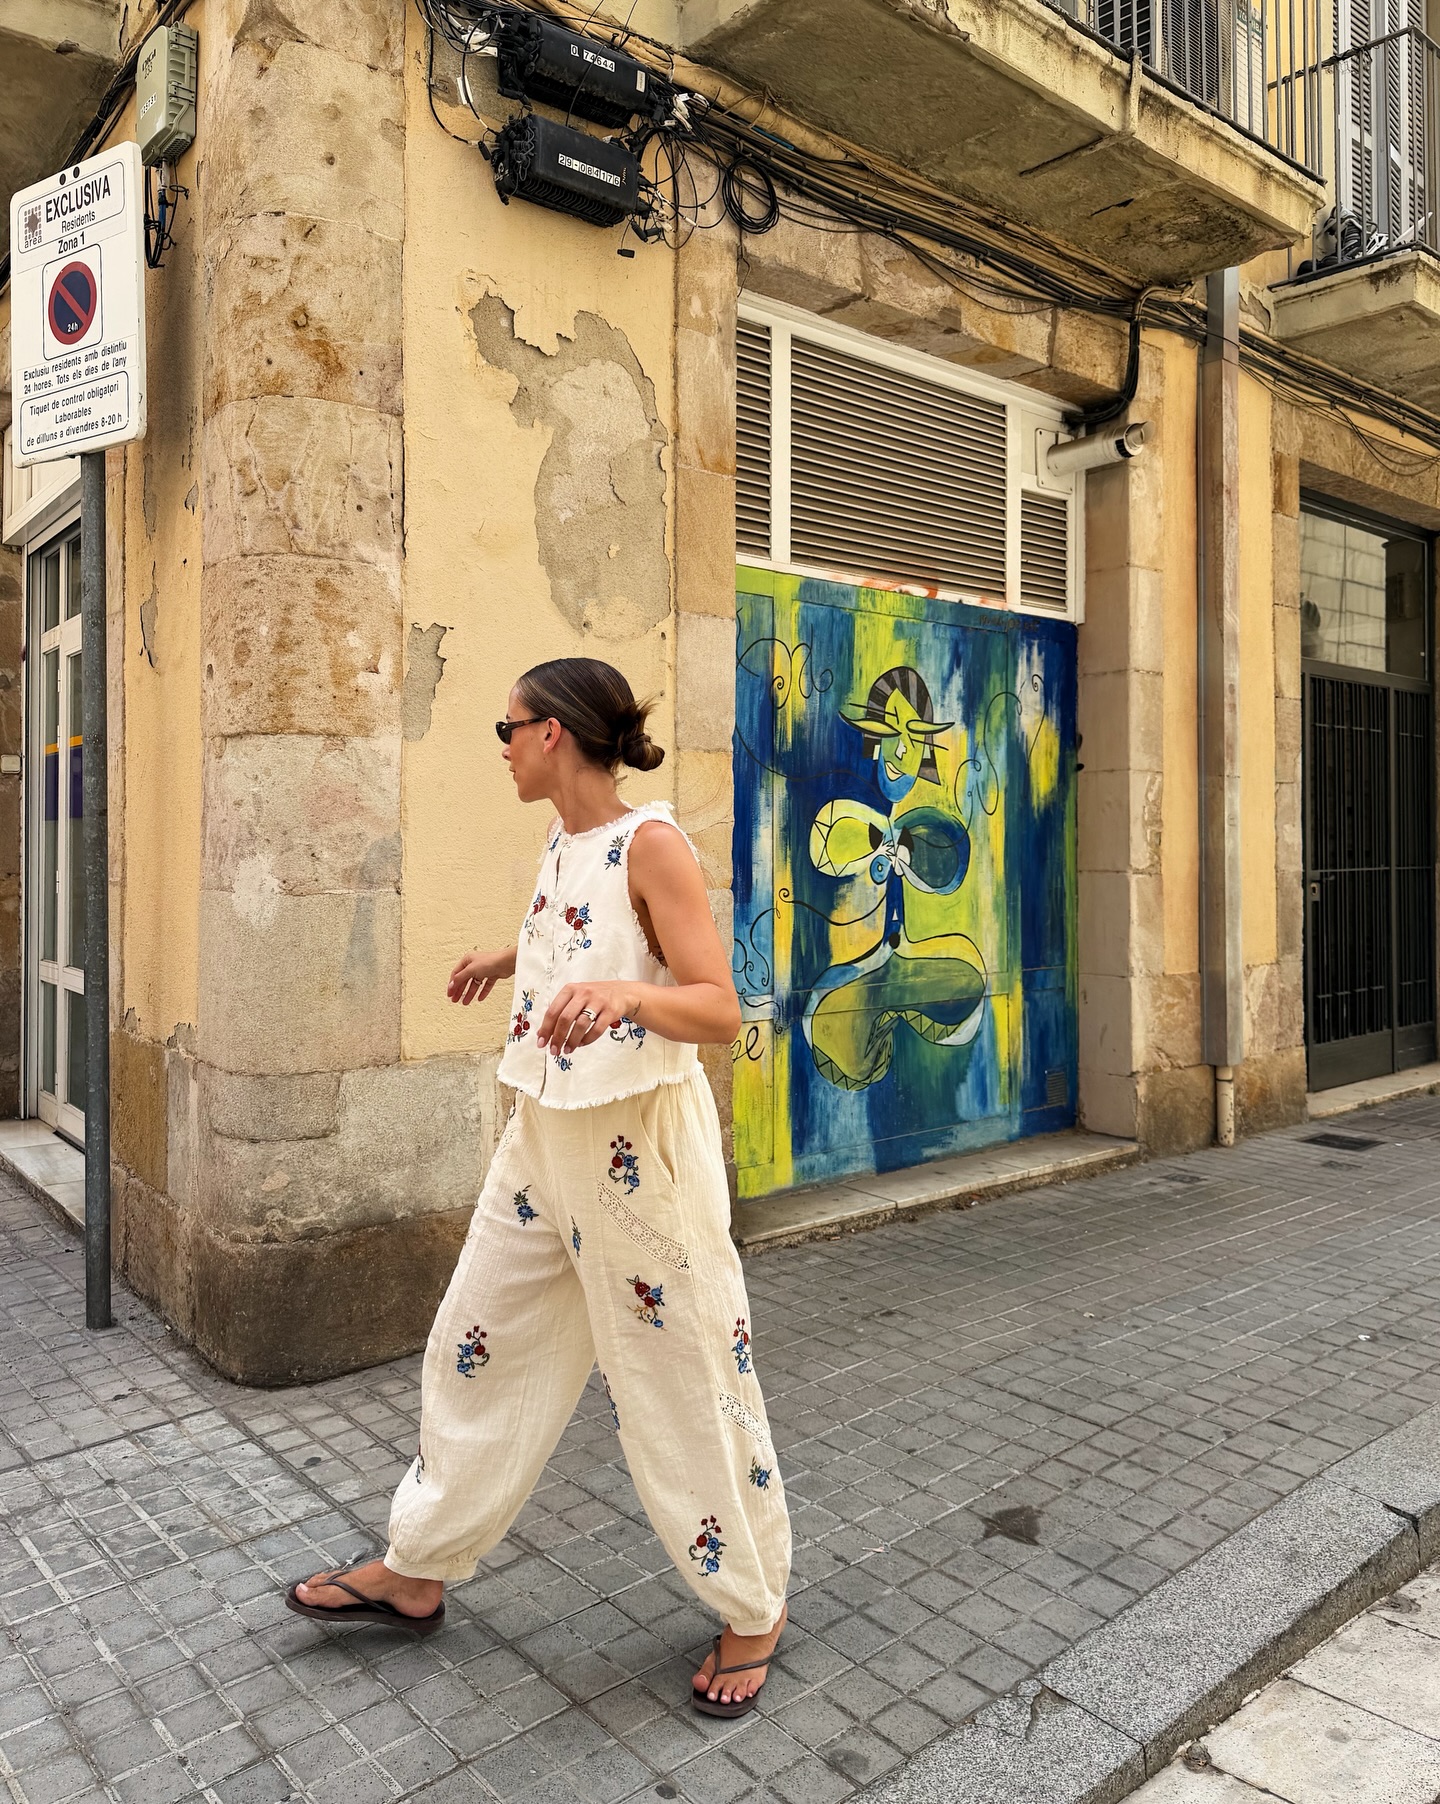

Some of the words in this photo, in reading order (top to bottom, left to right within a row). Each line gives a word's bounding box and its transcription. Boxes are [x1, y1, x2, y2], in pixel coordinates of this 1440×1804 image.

[45, 175, 111, 223] EXCLUSIVA
[61, 210, 96, 233] Residents
[24, 235, 43, 249] area
[58, 236, 78, 254] Zona
[80, 231, 86, 245] 1
[23, 366, 50, 382] Exclusiu
[51, 356, 82, 373] residents
[84, 349, 99, 363] amb
[101, 340, 127, 357] distintiu
[24, 384, 31, 395] 24
[33, 378, 54, 392] hores.
[56, 373, 70, 385] Tots
[72, 369, 82, 380] els
[84, 364, 99, 377] dies
[101, 360, 110, 372] de
[112, 356, 127, 368] l'any
[29, 403, 50, 417] Tiquet
[51, 399, 60, 410] de
[61, 391, 85, 407] control
[87, 380, 119, 400] obligatori
[55, 406, 92, 425] Laborables
[26, 436, 35, 447] de
[36, 430, 58, 445] dilluns
[59, 430, 64, 438] a
[66, 419, 99, 437] divendres
[101, 415, 116, 427] 8-20
[117, 413, 122, 423] h
